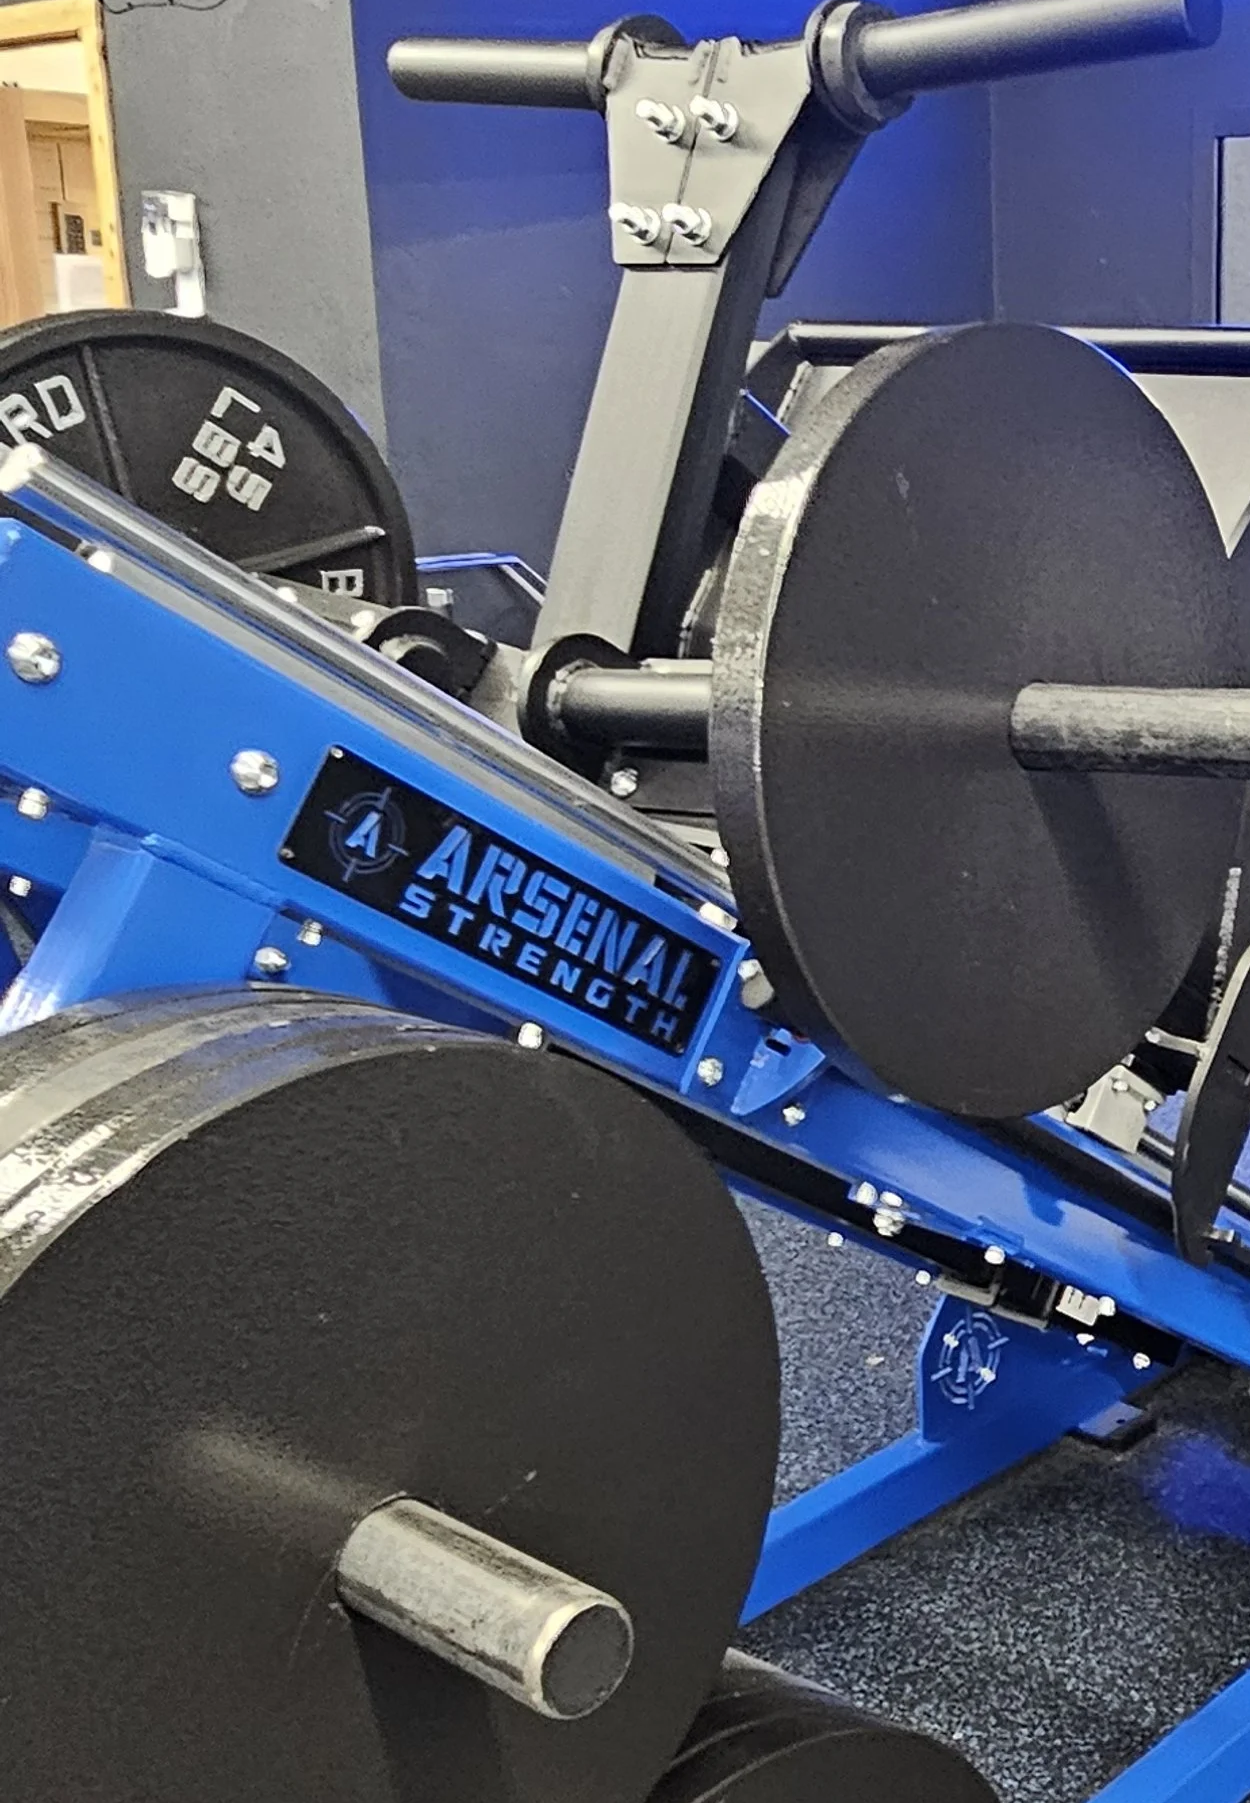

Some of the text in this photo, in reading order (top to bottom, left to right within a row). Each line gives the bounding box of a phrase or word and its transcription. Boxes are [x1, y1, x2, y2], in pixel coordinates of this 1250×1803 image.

[171, 386, 261, 503] LBS
[226, 422, 286, 511] 45
[400, 883, 681, 1044] STRENGTH
[416, 824, 697, 1011] ARSENAL
